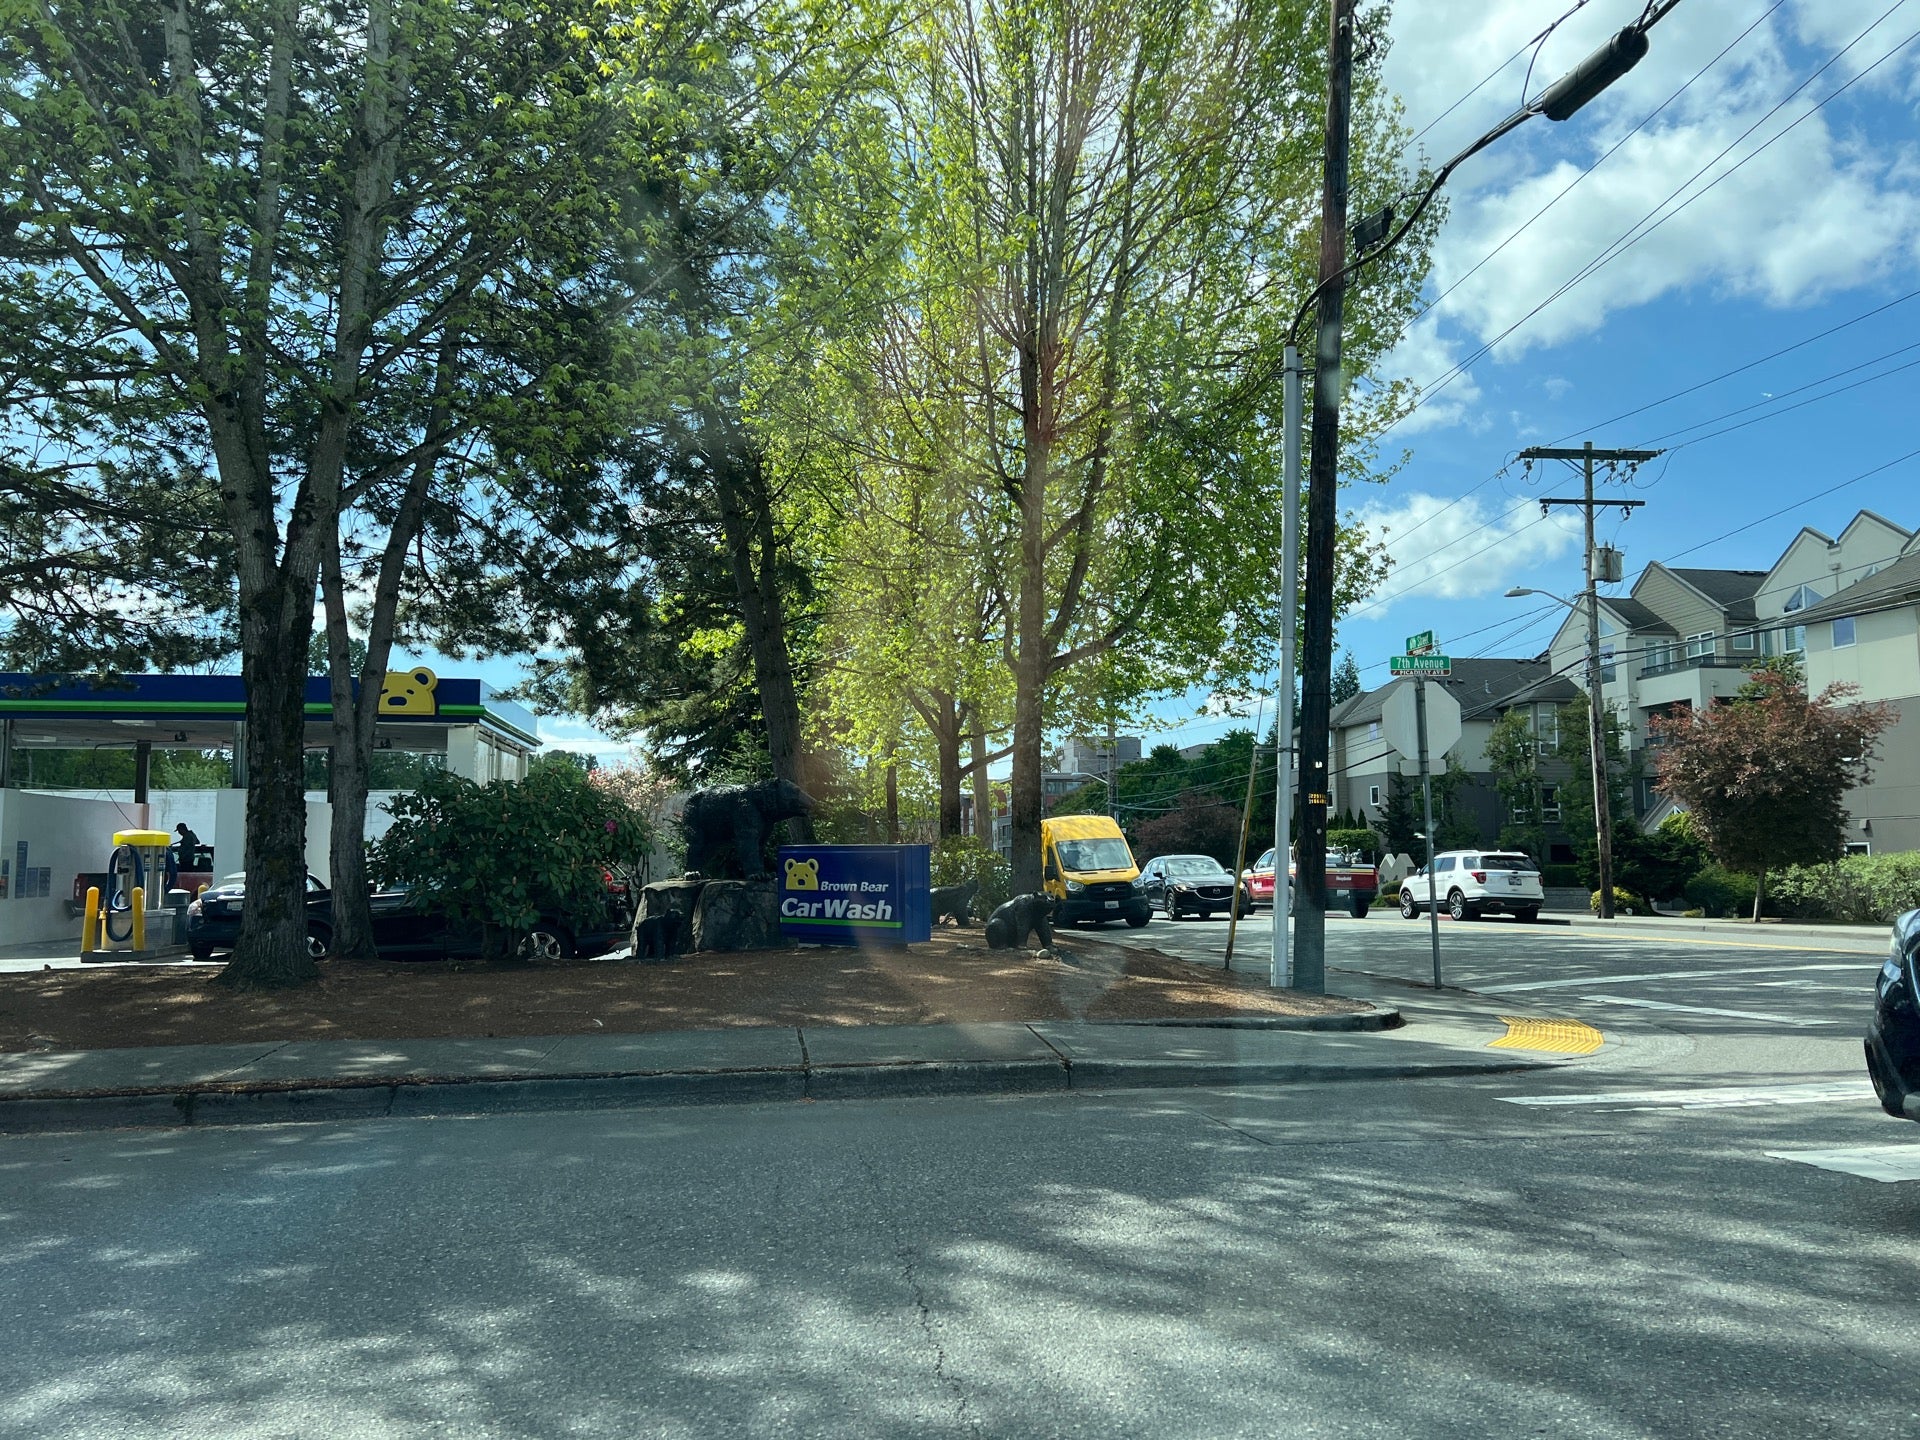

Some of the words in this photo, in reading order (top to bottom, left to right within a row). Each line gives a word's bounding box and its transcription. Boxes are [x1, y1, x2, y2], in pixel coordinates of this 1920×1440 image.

[1416, 633, 1429, 646] Street
[1396, 657, 1410, 669] 7th
[1413, 657, 1444, 669] Avenue
[820, 881, 857, 892] Brown
[860, 881, 889, 893] Bear
